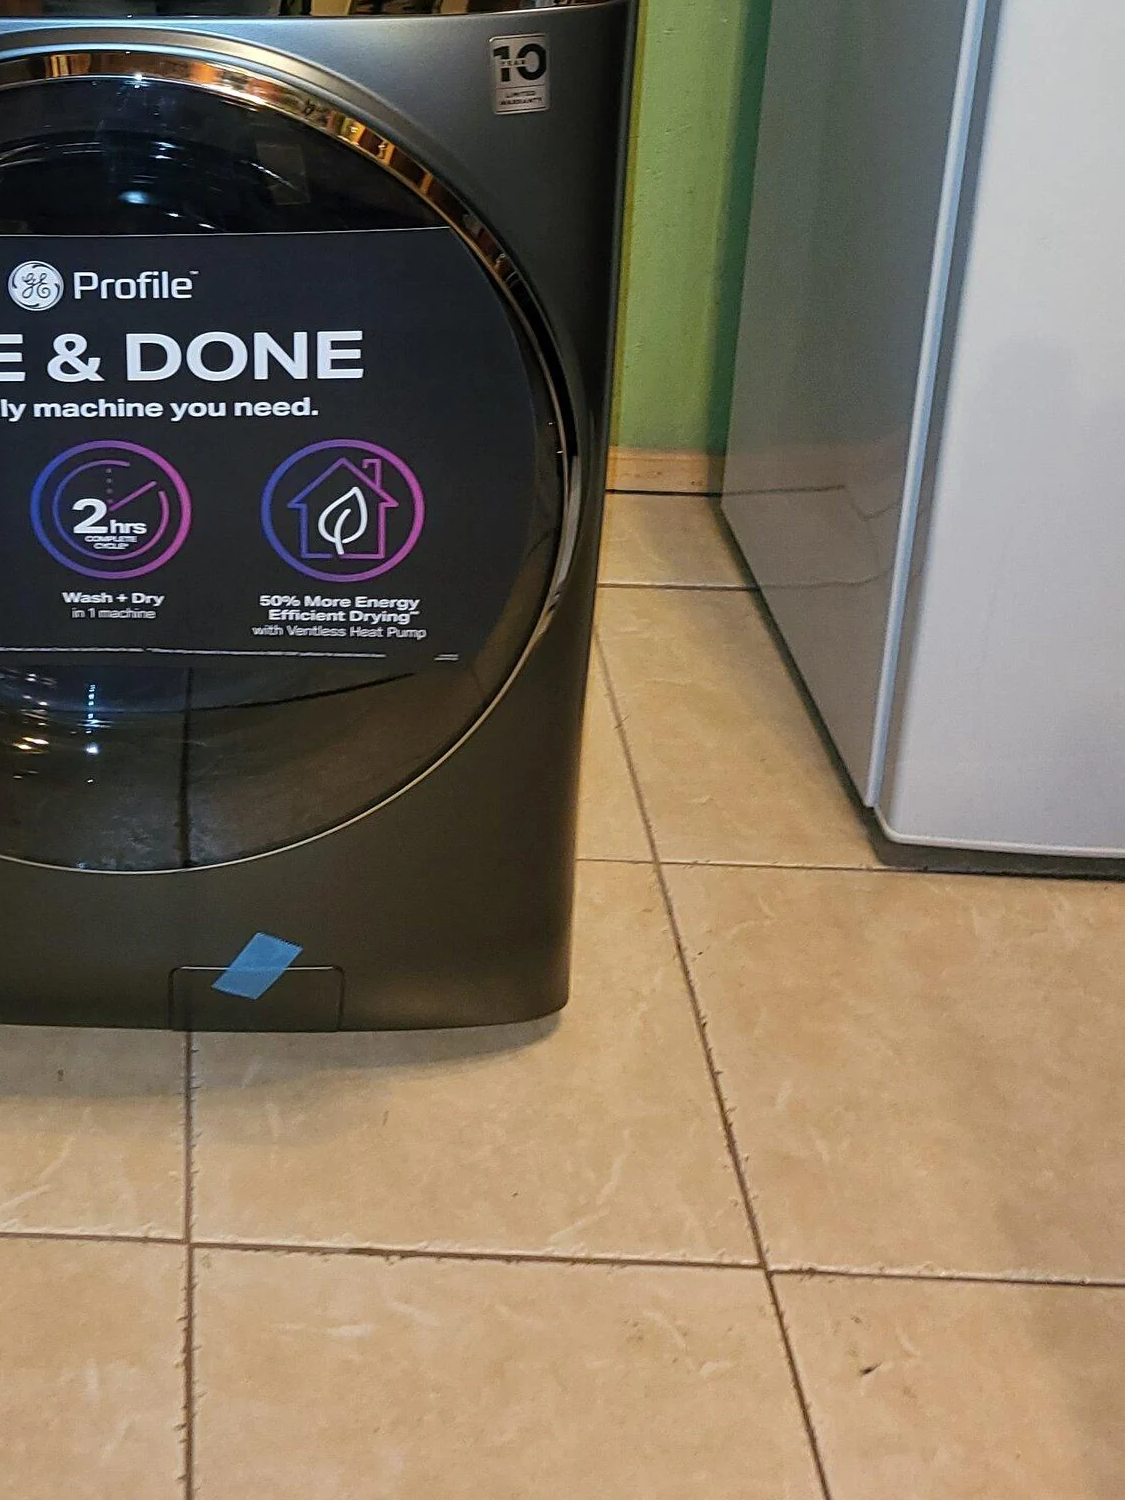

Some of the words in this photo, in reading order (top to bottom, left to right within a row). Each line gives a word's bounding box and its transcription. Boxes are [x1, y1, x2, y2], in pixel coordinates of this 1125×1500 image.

[493, 43, 547, 82] 10
[73, 271, 193, 299] Profile
[46, 332, 105, 383] &
[125, 330, 365, 382] DONE
[33, 398, 164, 418] machine
[170, 401, 226, 422] you
[233, 396, 319, 417] need.
[71, 498, 108, 534] 2
[110, 519, 148, 534] hrs
[84, 535, 138, 543] COMPLETE
[61, 591, 114, 603] Wash
[116, 594, 128, 603] +
[131, 592, 165, 606] Dry
[259, 595, 301, 607] 50%
[303, 595, 352, 608] More
[354, 596, 421, 611] Energy
[71, 607, 85, 618] in
[88, 607, 96, 618] 1
[98, 608, 157, 619] machine
[268, 609, 346, 622] Efficient
[252, 625, 284, 636] with
[286, 625, 347, 637] Ventless
[349, 626, 384, 638] Heat
[386, 627, 427, 640] Pump
